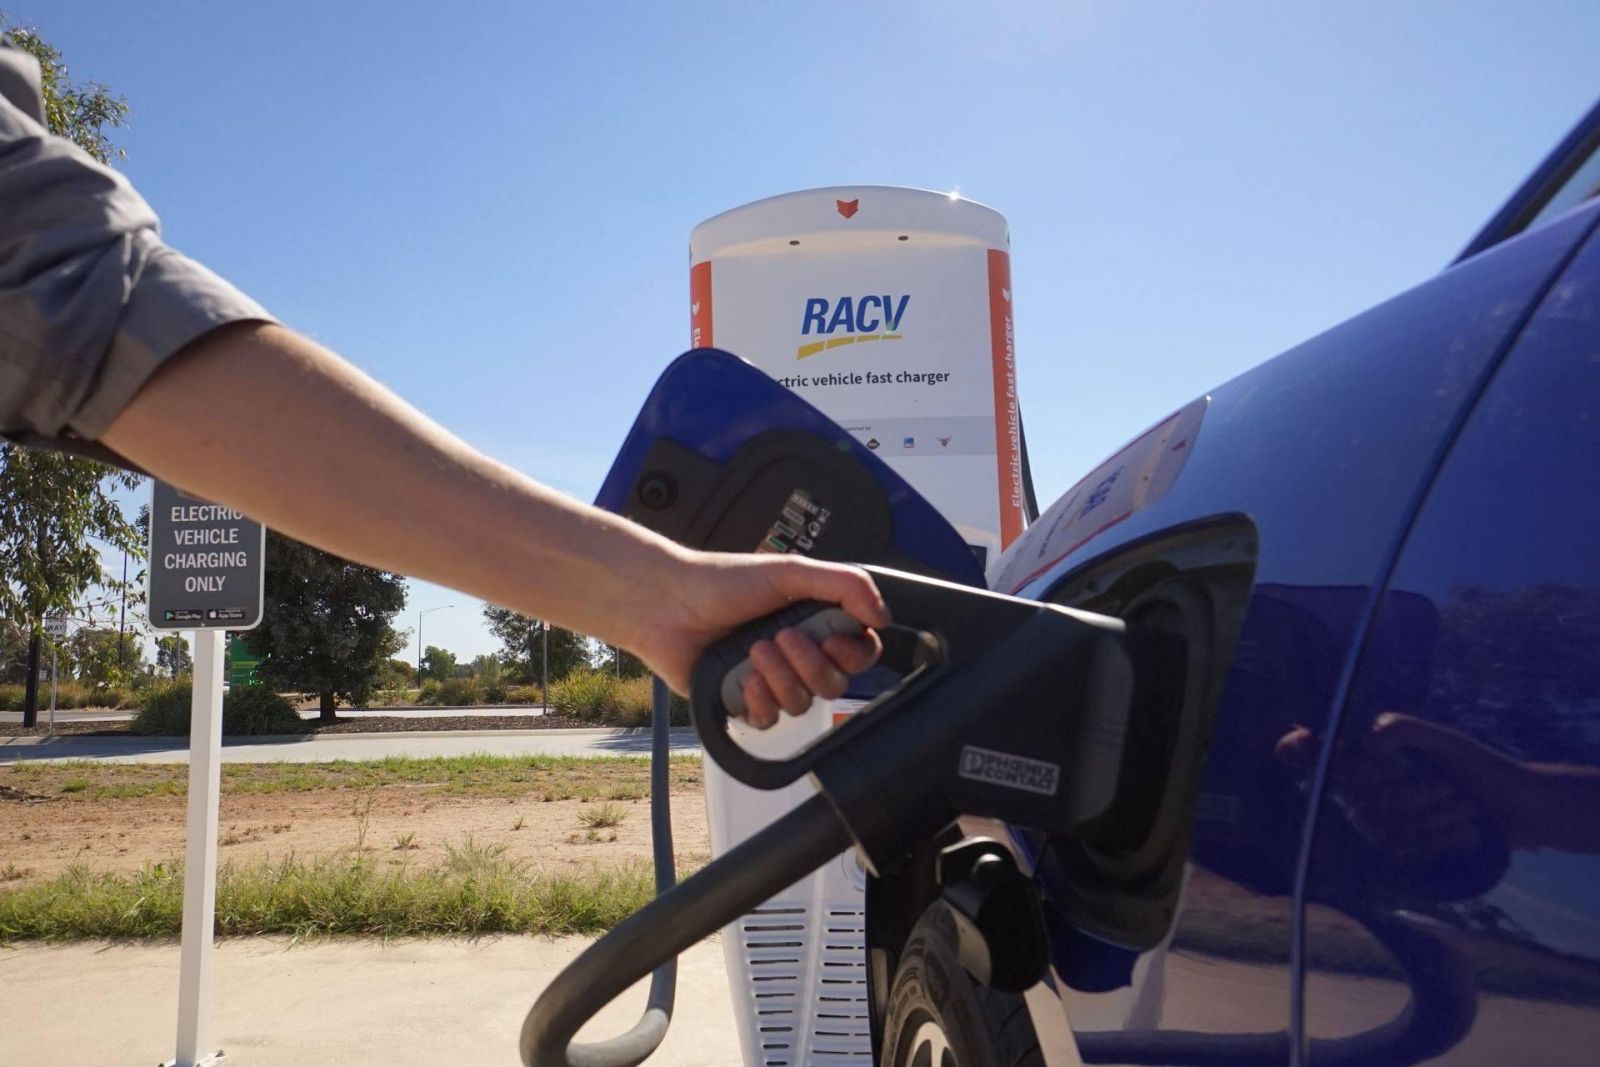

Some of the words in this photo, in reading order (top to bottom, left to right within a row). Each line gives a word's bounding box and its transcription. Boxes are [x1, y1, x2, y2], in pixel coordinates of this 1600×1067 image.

[801, 295, 911, 335] RACV
[1005, 315, 1014, 369] charger
[777, 374, 808, 388] ctric
[812, 372, 862, 386] vehicle
[866, 371, 893, 384] fast
[896, 370, 950, 385] charger
[1006, 371, 1015, 398] fast
[1008, 400, 1018, 450] vehicle
[1010, 454, 1020, 508] Electric
[174, 528, 239, 545] VEHICLE
[164, 551, 247, 569] CHARGING
[185, 575, 226, 592] ONLY
[985, 767, 1054, 790] CONTACT
